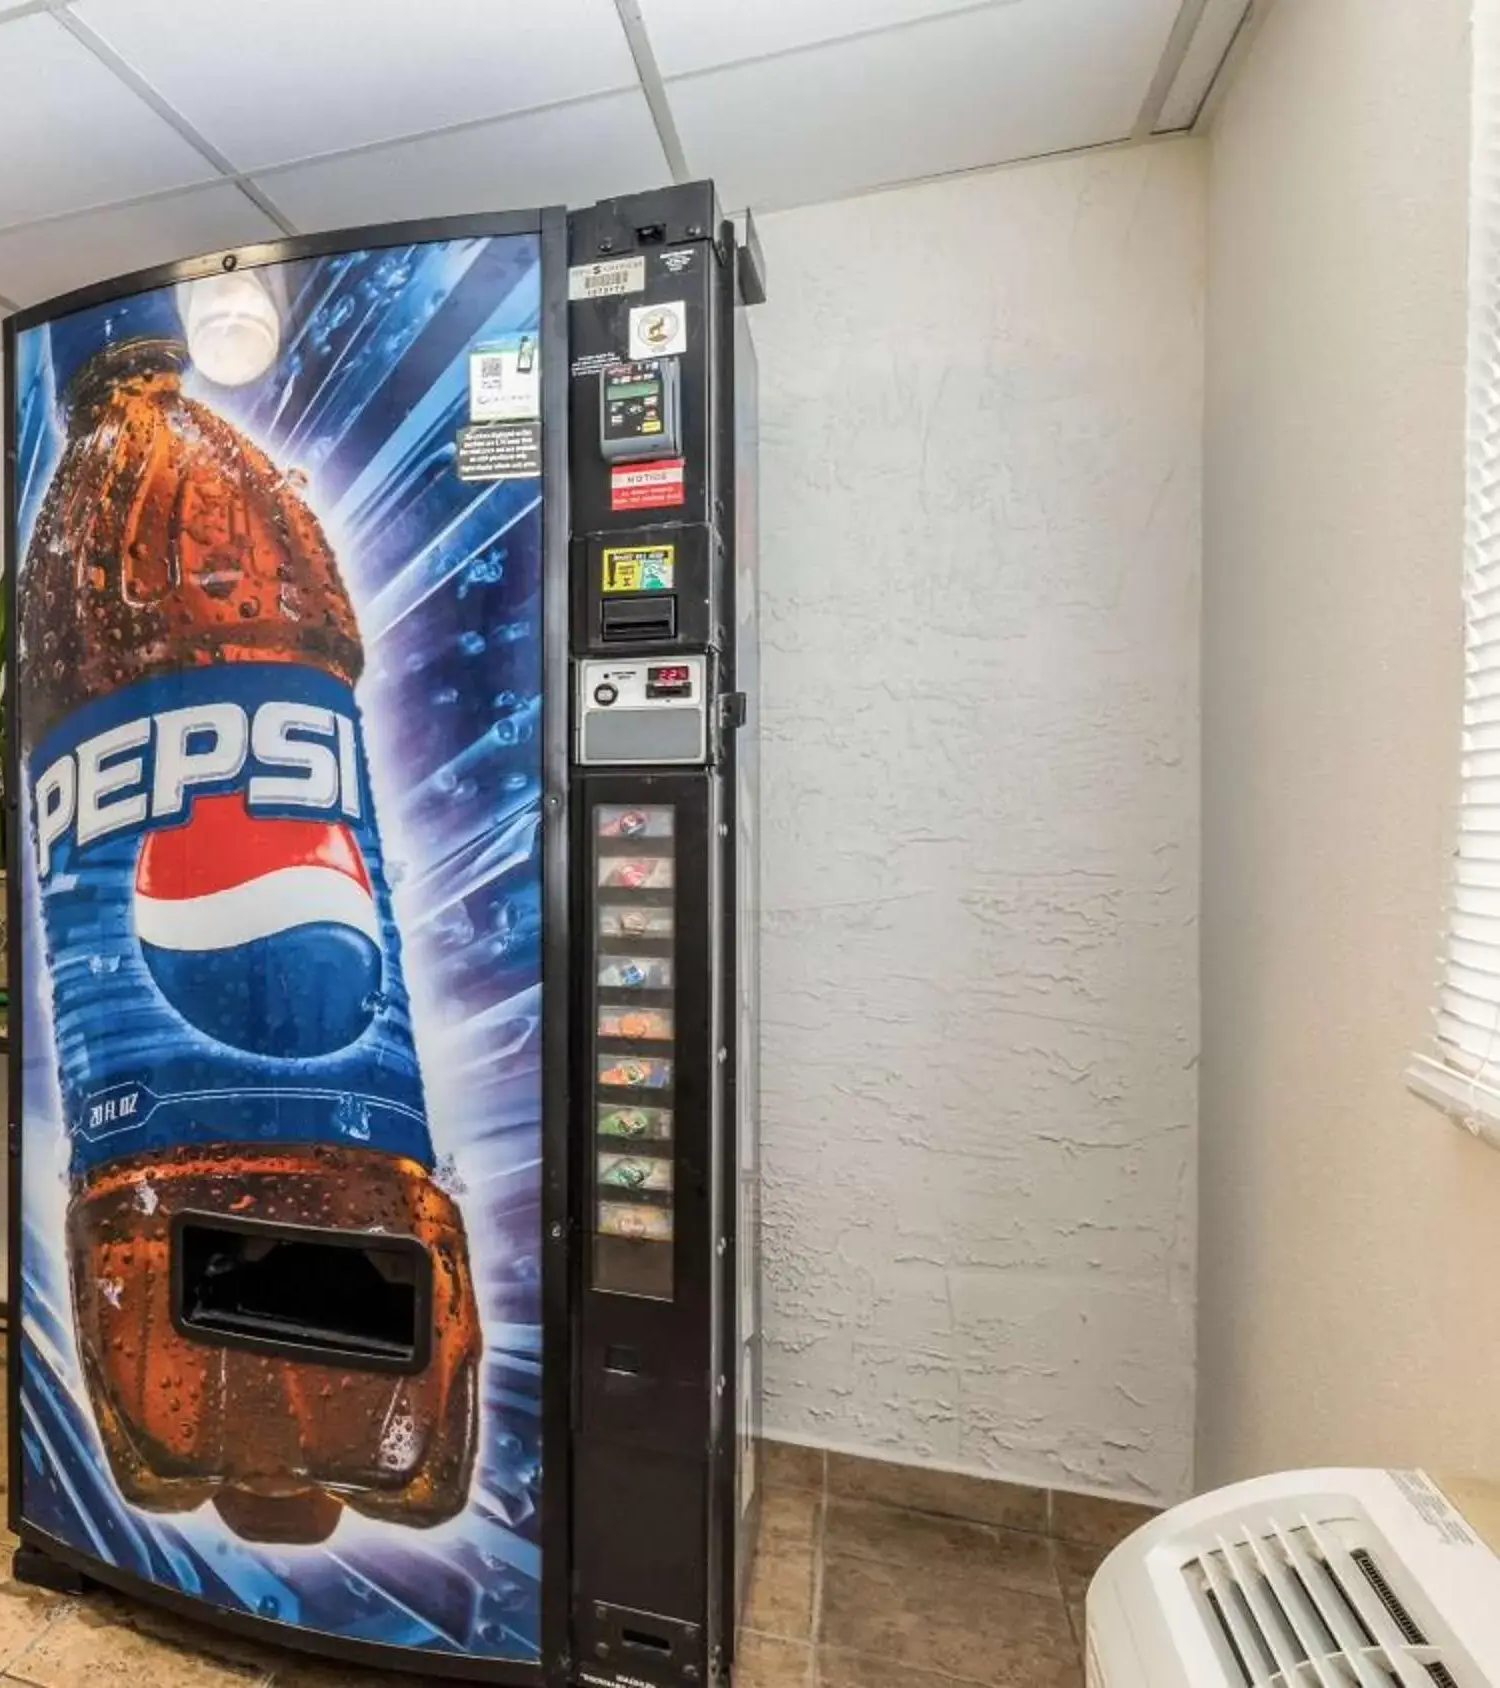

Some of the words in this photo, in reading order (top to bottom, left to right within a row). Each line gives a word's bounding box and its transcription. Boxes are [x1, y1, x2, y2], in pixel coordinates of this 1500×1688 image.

[35, 702, 361, 880] PEPSI
[90, 1104, 103, 1128] 20
[105, 1100, 119, 1123] FL
[119, 1091, 139, 1117] OZ
